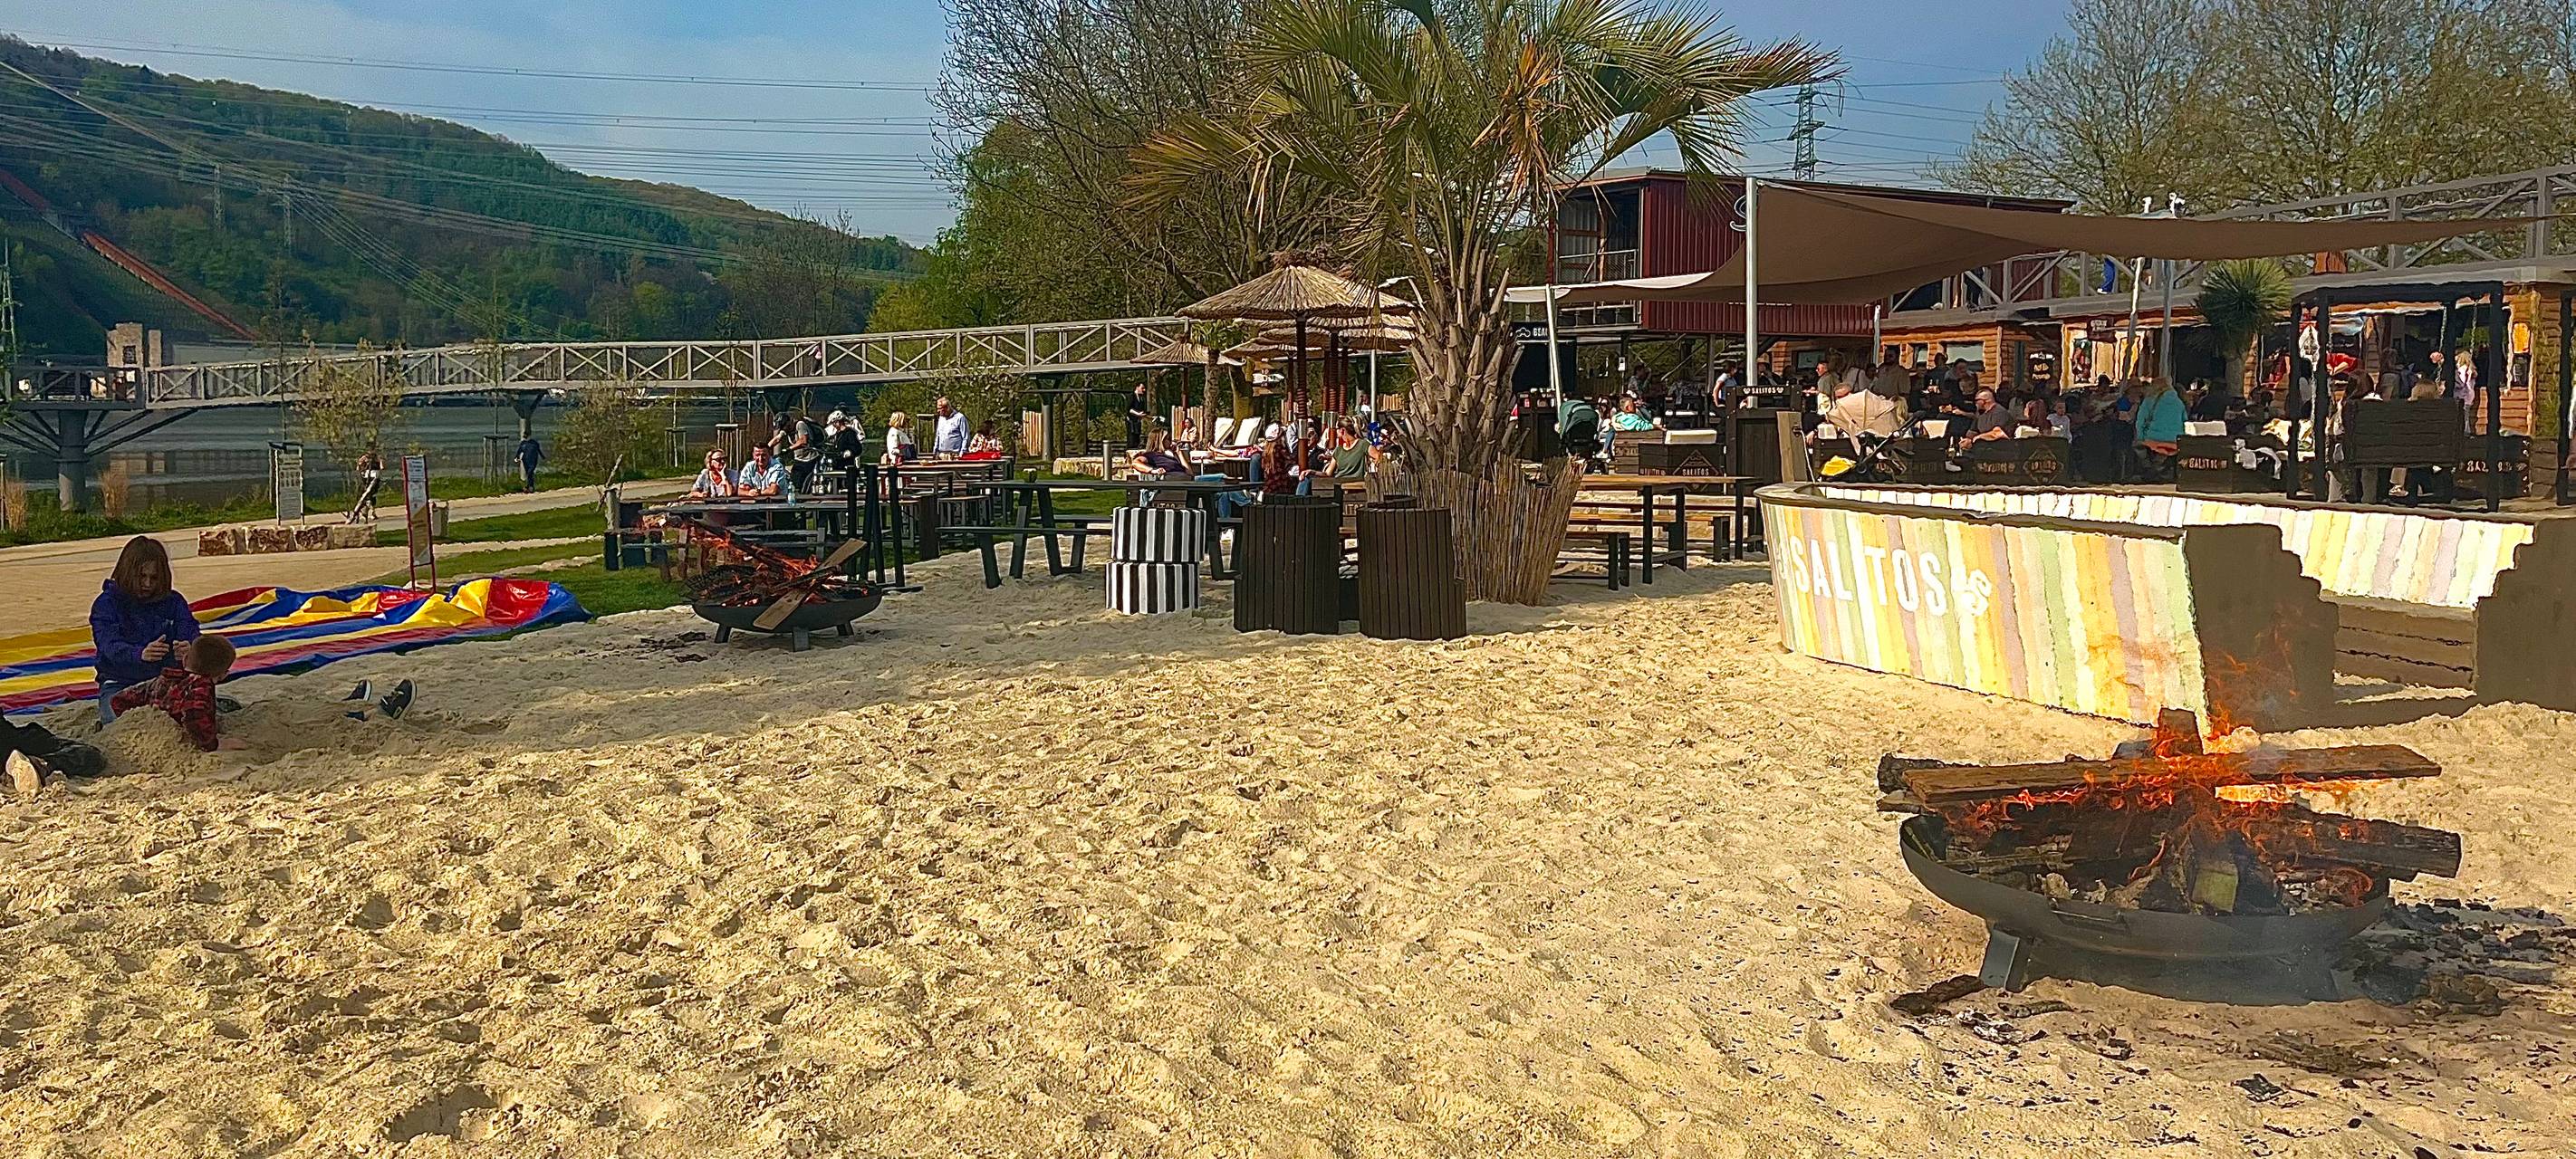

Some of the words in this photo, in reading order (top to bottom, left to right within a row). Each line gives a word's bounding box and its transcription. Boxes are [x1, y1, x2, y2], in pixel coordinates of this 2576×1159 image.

[1751, 387, 1776, 395] SALITOS
[1682, 468, 1710, 476] SALITOS
[1790, 535, 1947, 617] SALITOS
